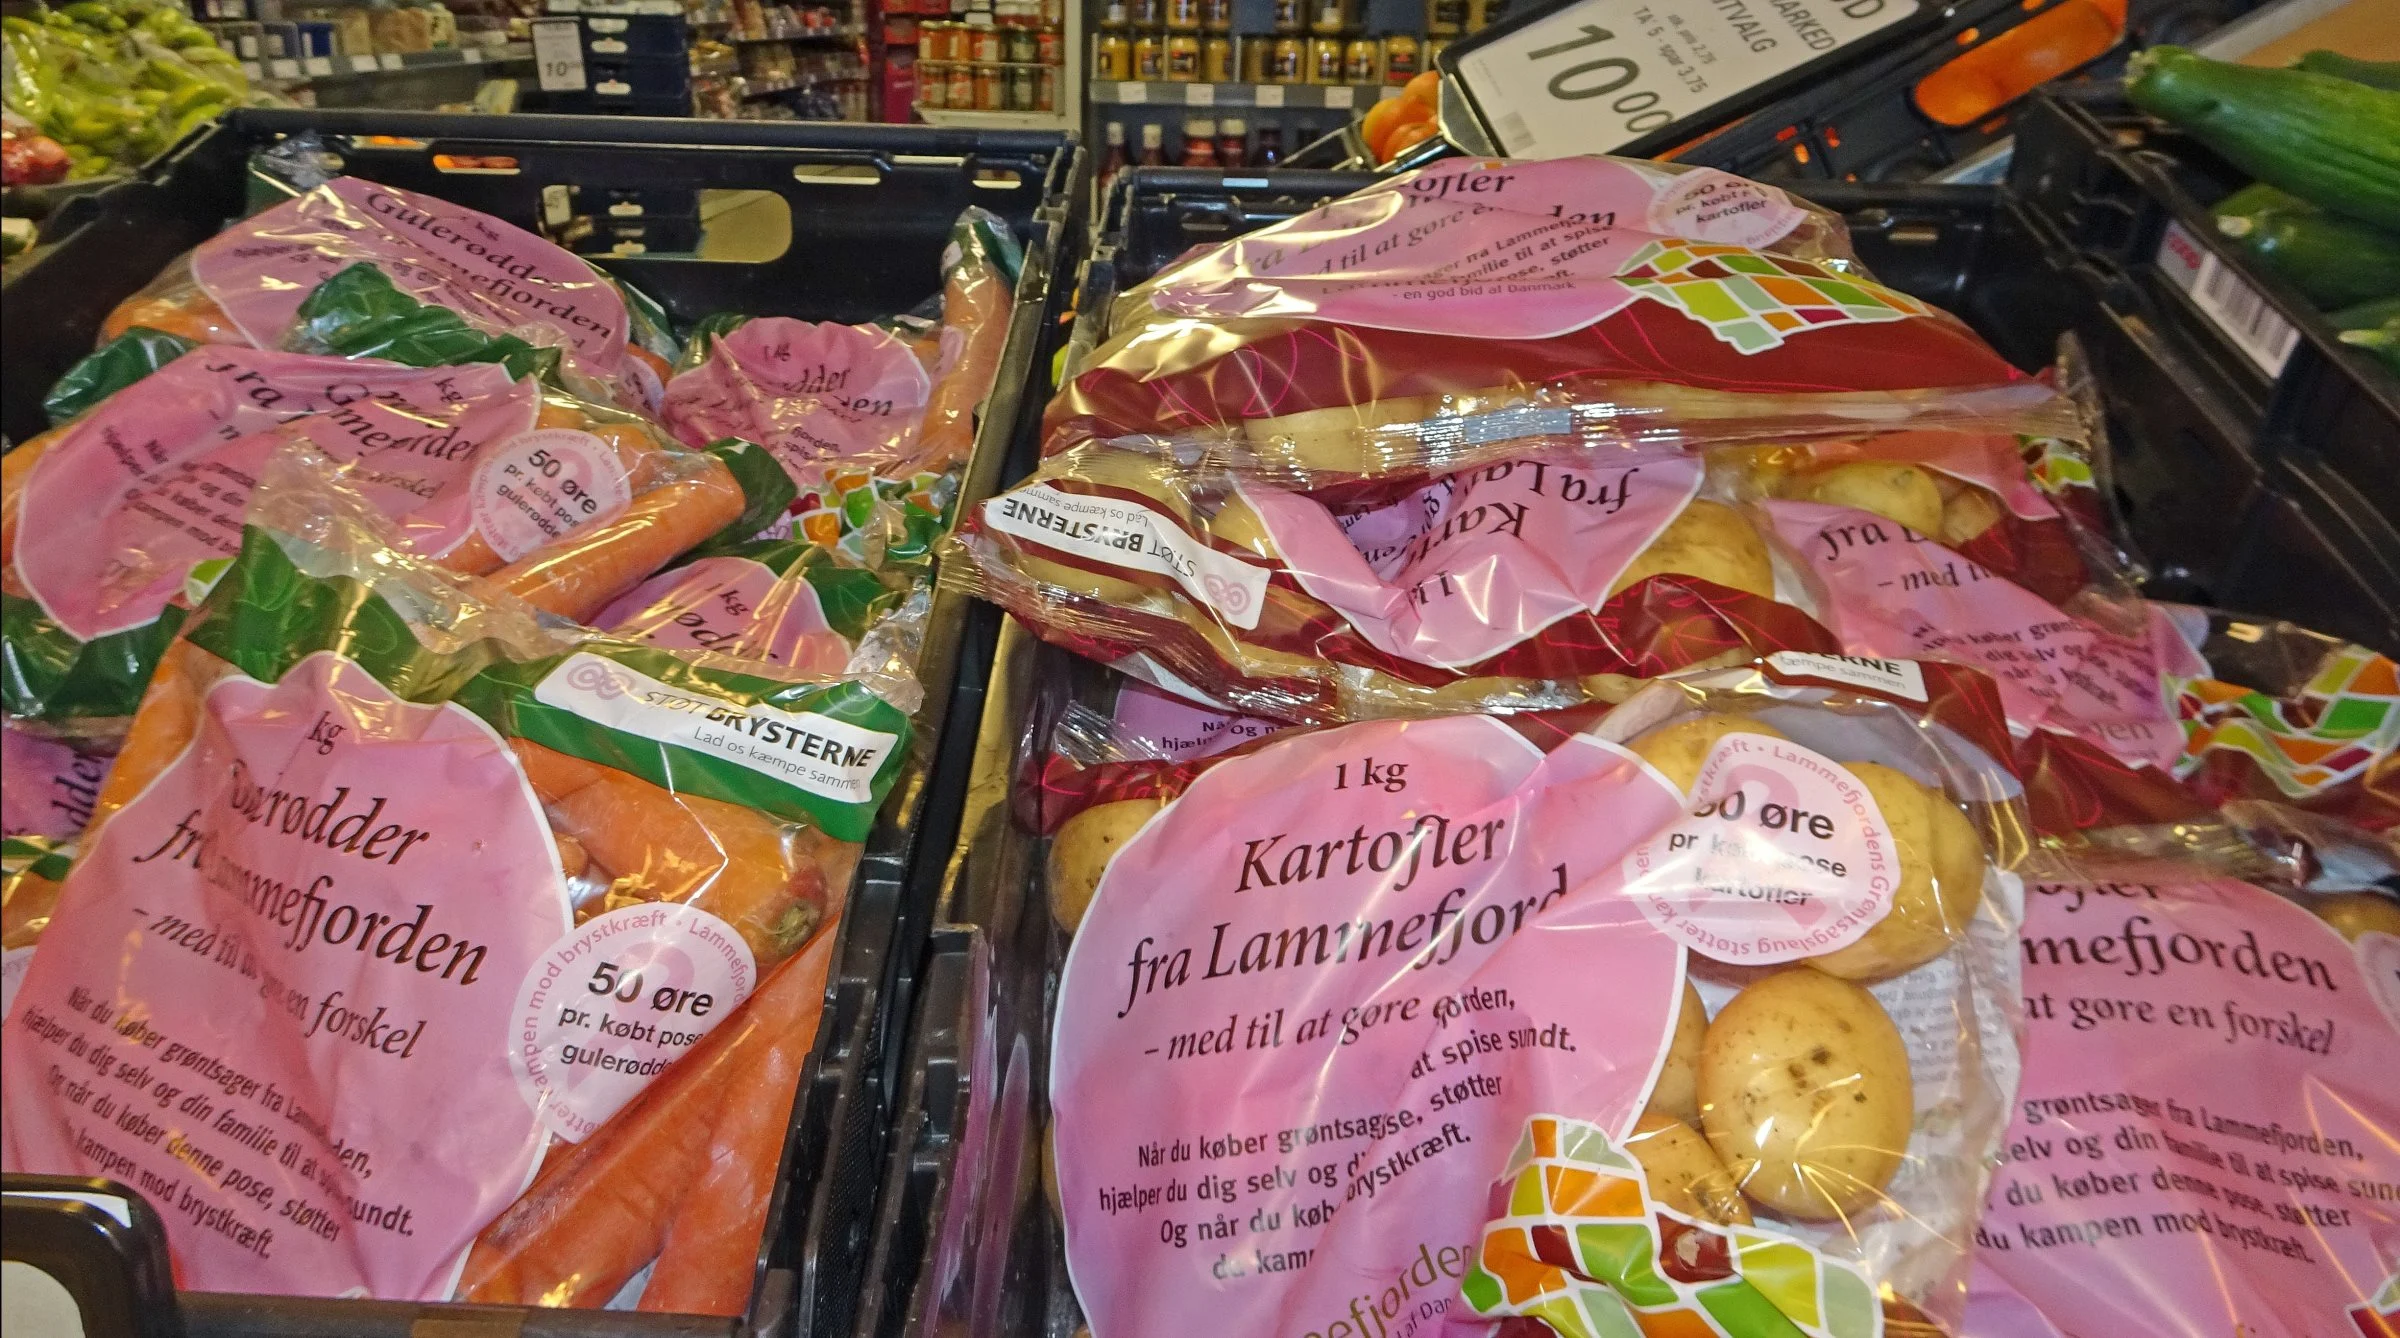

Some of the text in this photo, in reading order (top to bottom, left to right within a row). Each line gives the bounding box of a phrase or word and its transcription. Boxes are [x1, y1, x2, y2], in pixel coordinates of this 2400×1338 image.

[1527, 24, 1640, 101] 10
[1375, 232, 1400, 256] at
[1427, 287, 1456, 302] god
[1460, 285, 1485, 297] bid
[528, 449, 597, 514] 50 øre
[1560, 467, 1640, 515] fra
[1003, 498, 1197, 578] STØT BRYSTERNE
[1063, 501, 1150, 528] Lad os kæmpe
[308, 711, 347, 755] kg
[645, 690, 878, 769] STØT BRYSTERNE
[694, 726, 725, 749] Lad
[727, 742, 745, 754] os
[748, 745, 808, 777] kæmpe
[1335, 757, 1409, 793] 1 kg
[1758, 803, 1837, 840] øre
[1234, 814, 1505, 893] Kartofler
[528, 961, 562, 1012] mod
[556, 909, 668, 965] brystkræft
[1675, 914, 1752, 957] støtter
[588, 961, 714, 1017] 50 øre
[1117, 936, 1191, 1019] fra
[90, 999, 113, 1025] du
[112, 1012, 166, 1049] køber
[159, 1041, 264, 1100] grøntsager
[261, 1082, 285, 1110] fra
[305, 990, 428, 1060] forskel
[558, 1006, 657, 1043] pr. købt
[1167, 995, 1422, 1062] med til at gøre
[1441, 1032, 1505, 1067] spise
[1508, 1022, 1578, 1054] sundt.
[2070, 995, 2158, 1032] gøre
[2168, 996, 2216, 1030] en
[2222, 1000, 2336, 1056] forskel
[68, 1031, 90, 1057] du
[89, 1038, 118, 1077] dig
[115, 1059, 155, 1090] selv
[152, 1081, 184, 1108] og
[180, 1088, 212, 1121] din
[211, 1107, 279, 1157] familie
[278, 1140, 300, 1170] til
[1137, 1142, 1168, 1168] Når
[1170, 1138, 1192, 1164] du
[1198, 1127, 1269, 1163] køber
[1429, 1073, 1504, 1112] støtter
[65, 1076, 95, 1106] når
[90, 1091, 117, 1121] du
[114, 1104, 170, 1147] køber
[164, 1129, 225, 1178] denne
[221, 1166, 275, 1211] pose,
[279, 1198, 341, 1243] støtter
[2065, 1133, 2104, 1159] og
[2113, 1125, 2160, 1151] din
[2279, 1166, 2342, 1197] spise
[2199, 1105, 2365, 1162] Lammefjorden,
[140, 1167, 178, 1202] mod
[177, 1185, 273, 1260] brystkræft.
[1099, 1160, 1341, 1216] hjælper du dig selv og
[2003, 1179, 2044, 1208] du
[2053, 1168, 2143, 1199] køber
[2274, 1200, 2353, 1229] støtter
[1160, 1219, 1189, 1249] Og
[1197, 1214, 1239, 1243] når
[1249, 1205, 1283, 1235] du
[1975, 1222, 2013, 1251] du
[2020, 1210, 2143, 1250] kampen
[2151, 1208, 2215, 1236] mod
